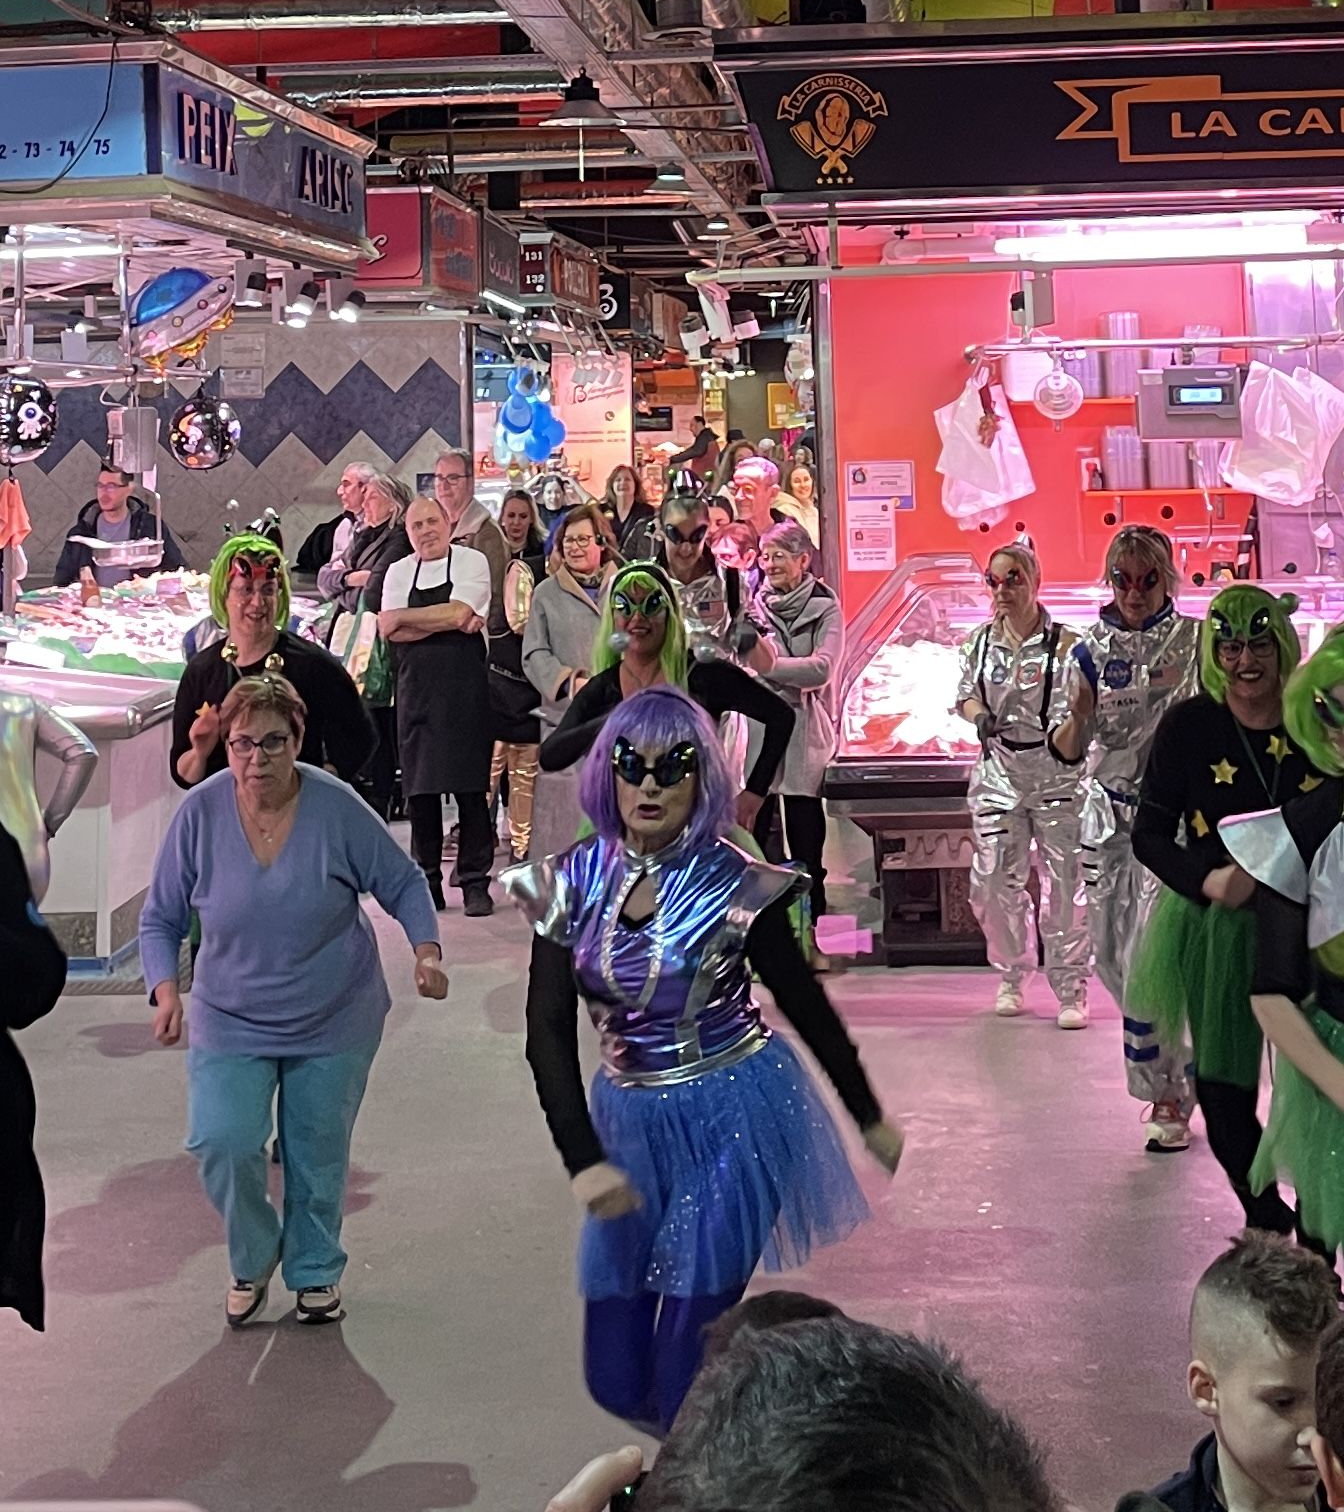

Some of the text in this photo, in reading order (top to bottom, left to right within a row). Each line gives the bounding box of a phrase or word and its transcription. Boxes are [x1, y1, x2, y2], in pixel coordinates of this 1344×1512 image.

[791, 77, 871, 107] LA CARNISSERIA
[177, 91, 238, 176] PEIX
[1170, 110, 1237, 138] LA
[24, 142, 40, 159] 73
[59, 140, 75, 157] 74
[94, 139, 111, 155] 75
